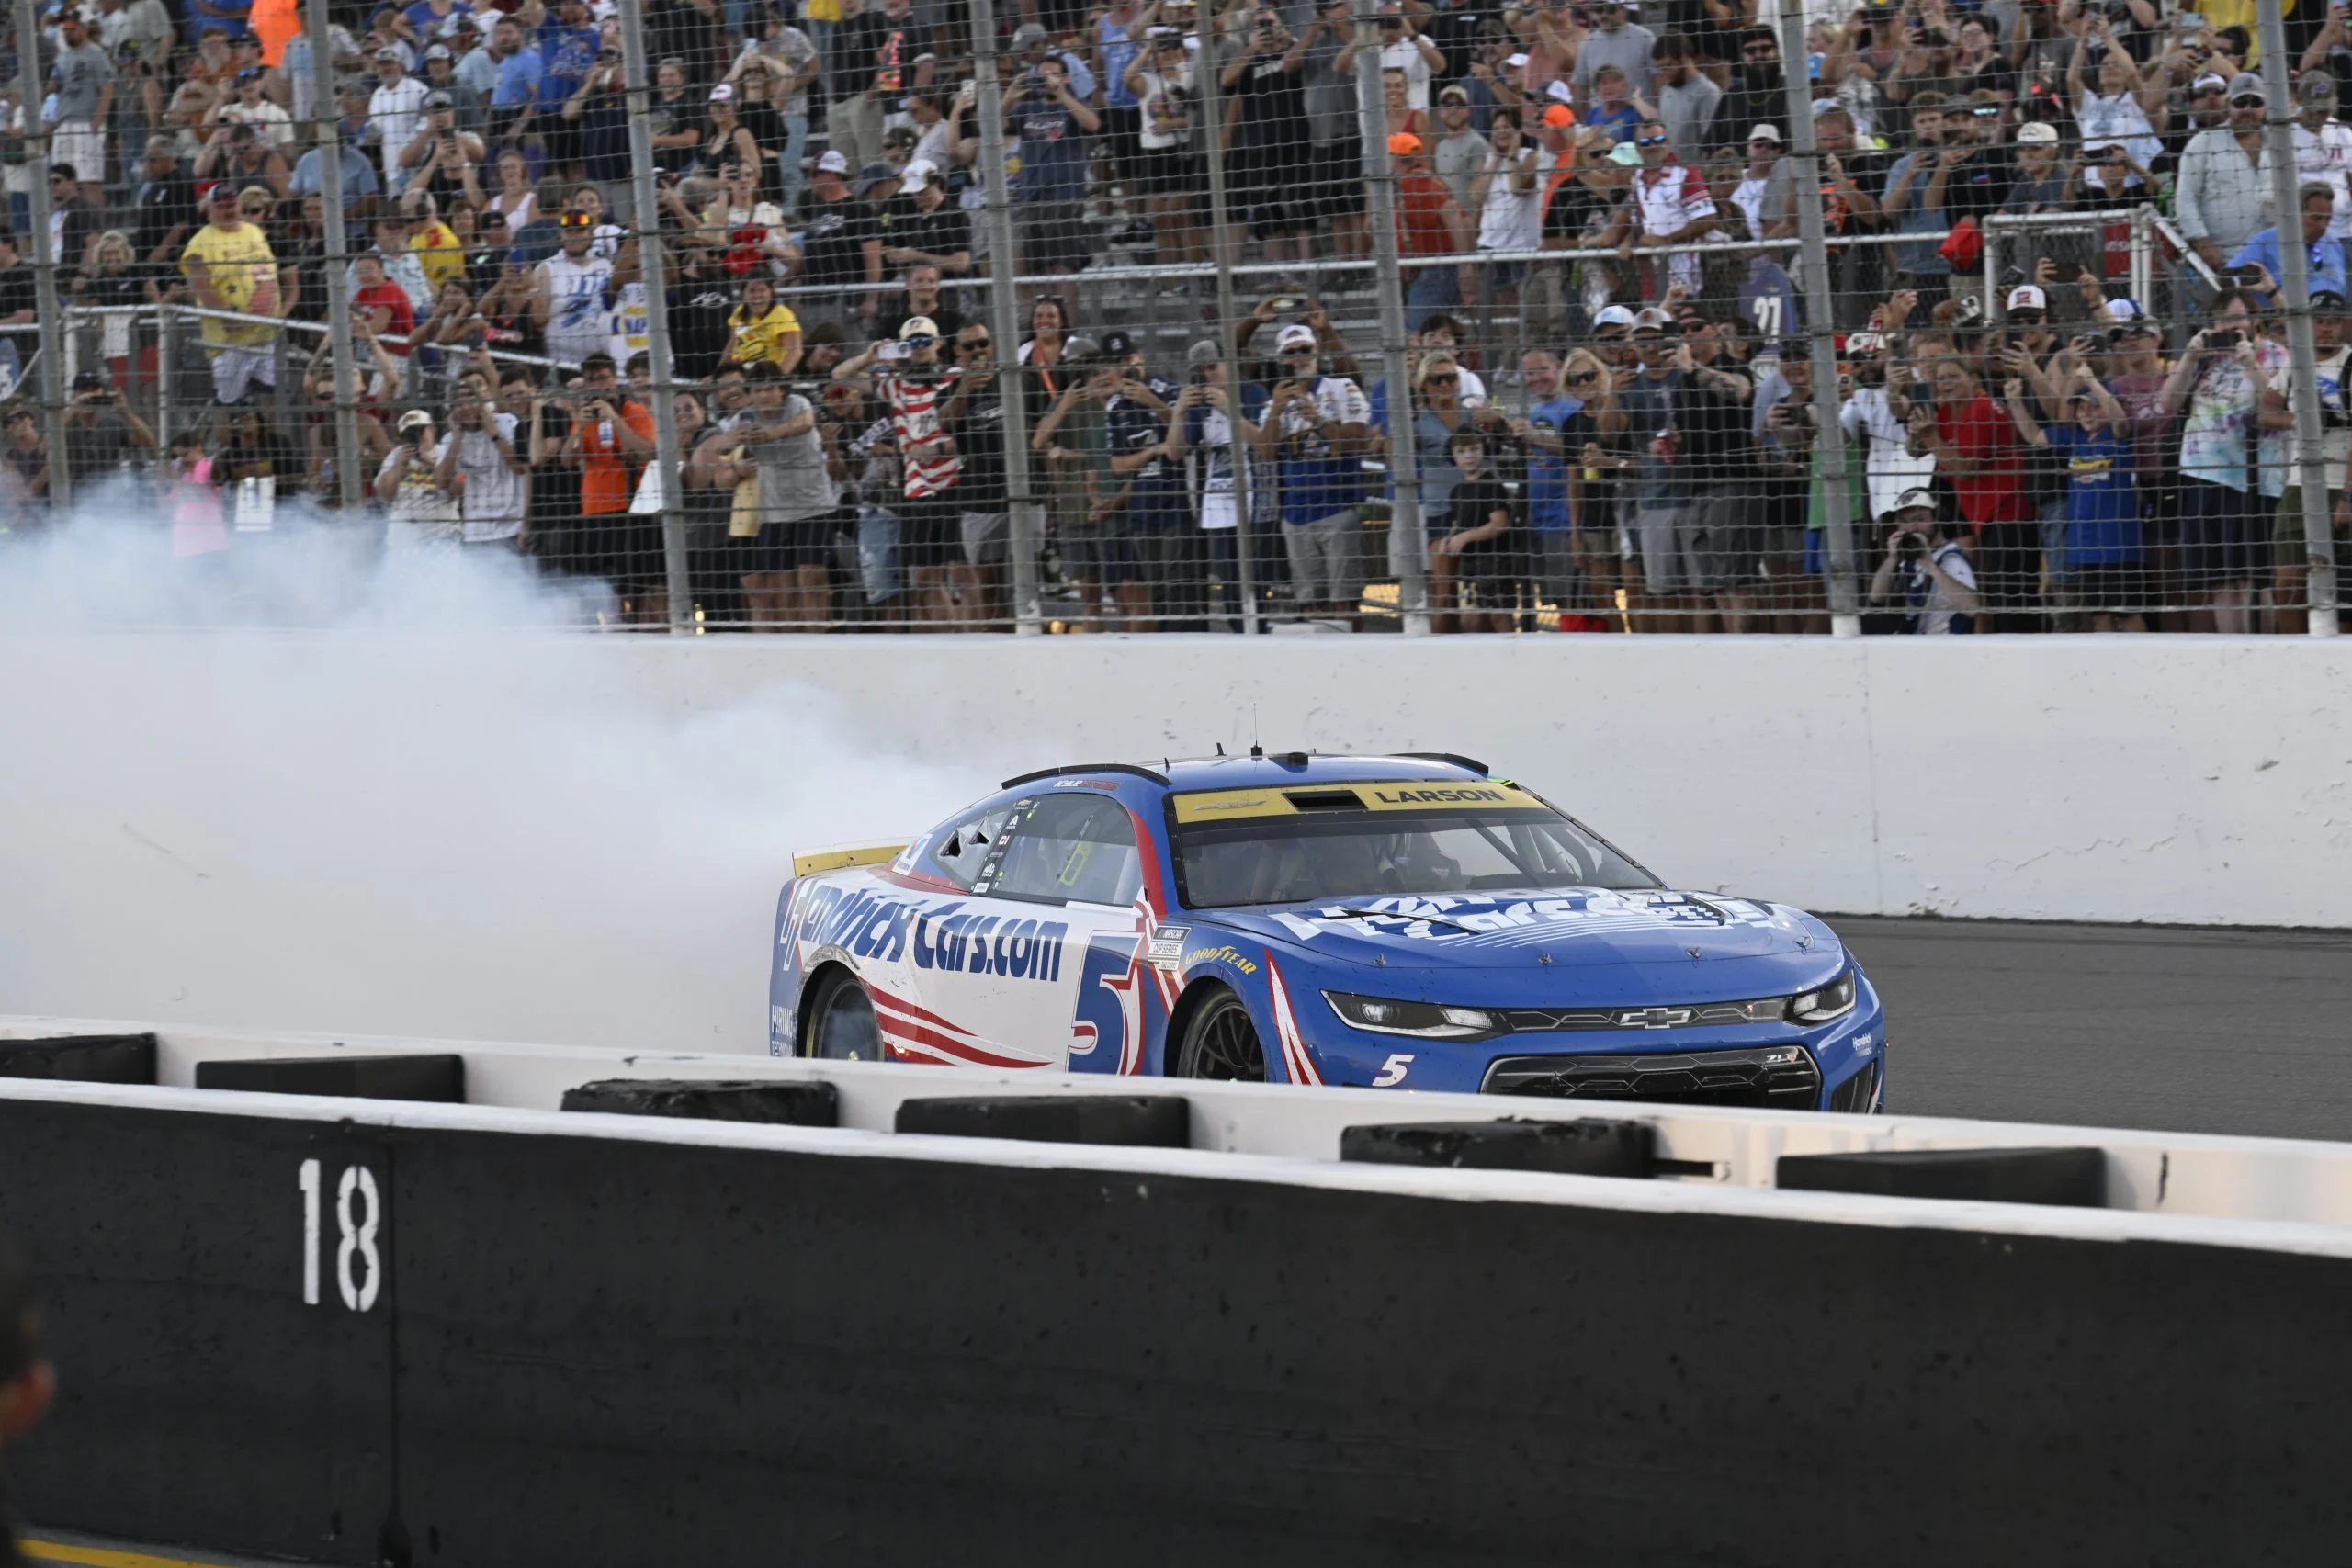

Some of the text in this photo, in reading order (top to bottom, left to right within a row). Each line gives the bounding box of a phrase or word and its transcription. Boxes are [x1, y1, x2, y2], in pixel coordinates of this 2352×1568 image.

[1374, 789, 1507, 804] LARSON
[1372, 1054, 1415, 1087] 5
[299, 1158, 380, 1312] 18
